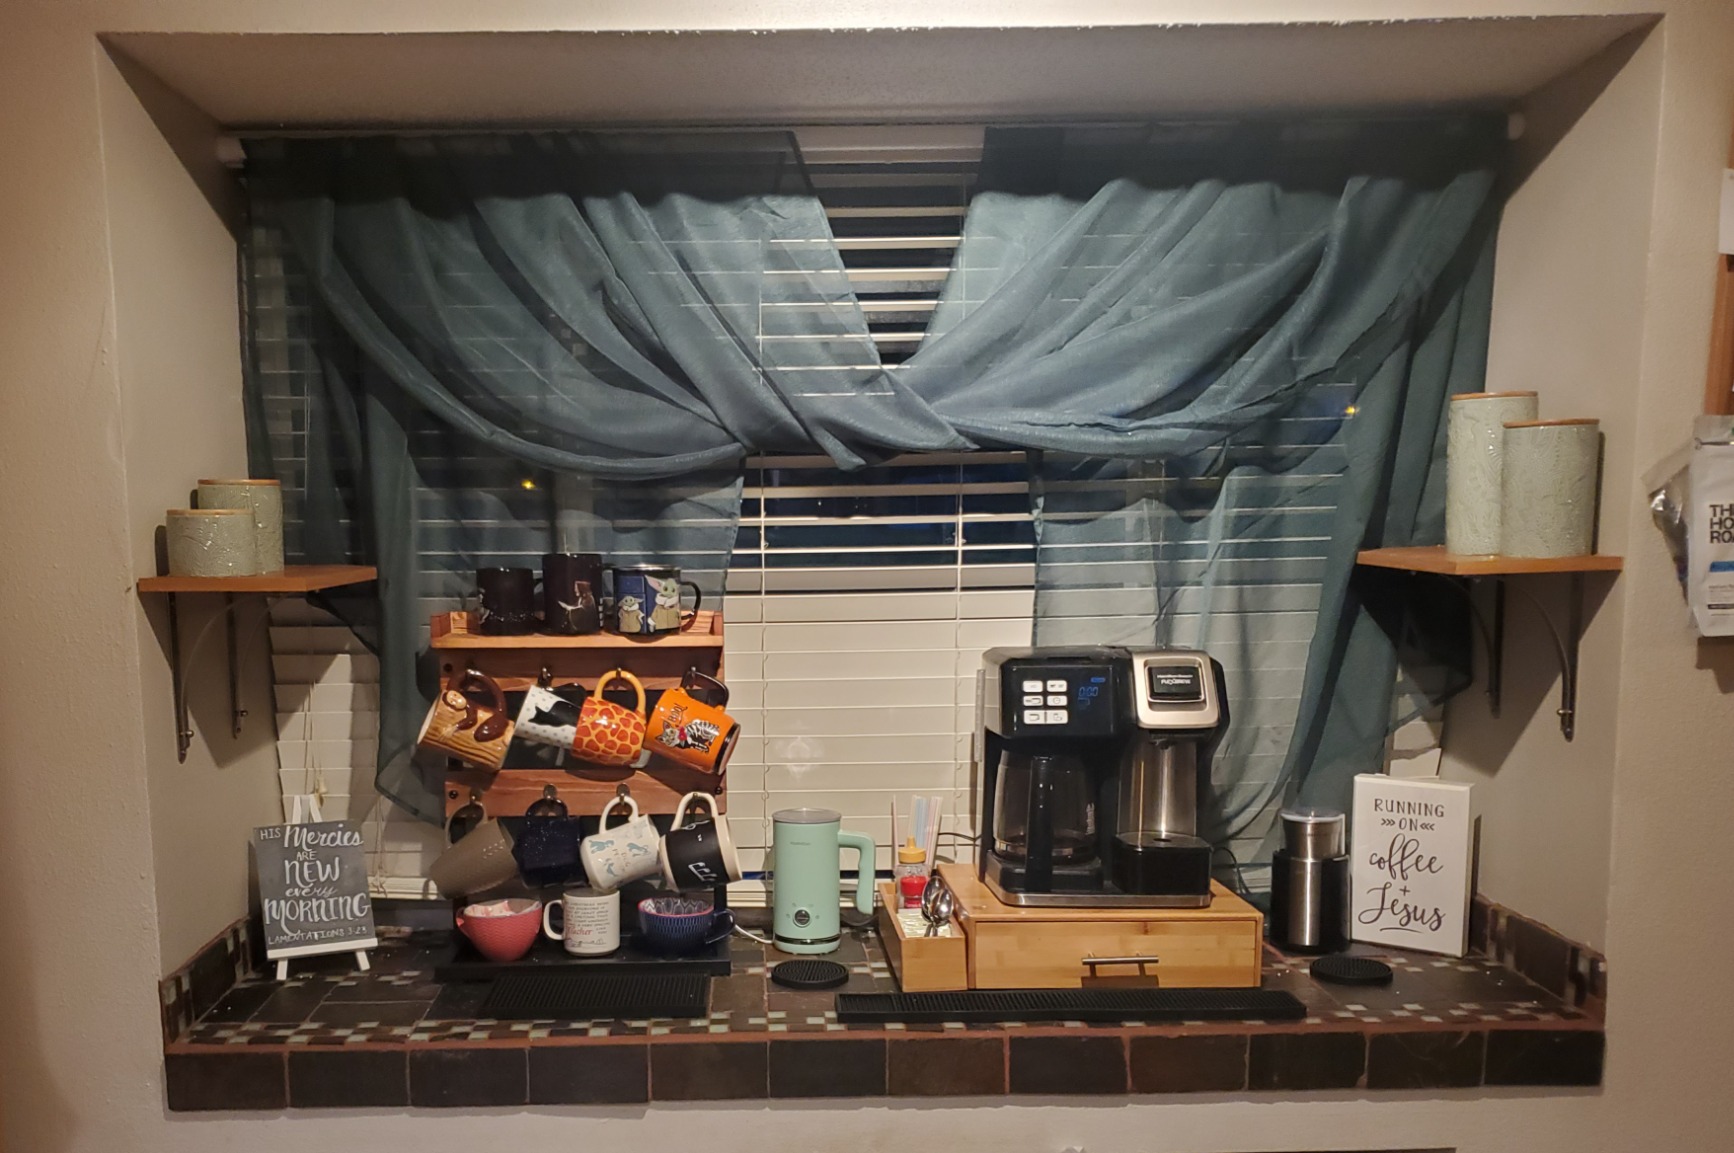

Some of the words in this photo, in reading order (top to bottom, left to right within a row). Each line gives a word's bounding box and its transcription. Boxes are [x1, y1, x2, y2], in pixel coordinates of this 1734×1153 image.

[1374, 798, 1445, 818] RUNNING
[1399, 817, 1418, 831] ON
[260, 827, 281, 840] HIS
[284, 823, 364, 852] Mercies
[296, 850, 317, 861] ARE
[1369, 833, 1444, 881] coffee
[285, 886, 338, 898] every
[264, 893, 371, 936] MORNING
[1358, 881, 1446, 932] Jesus
[268, 928, 345, 945] LAMENTATIONS
